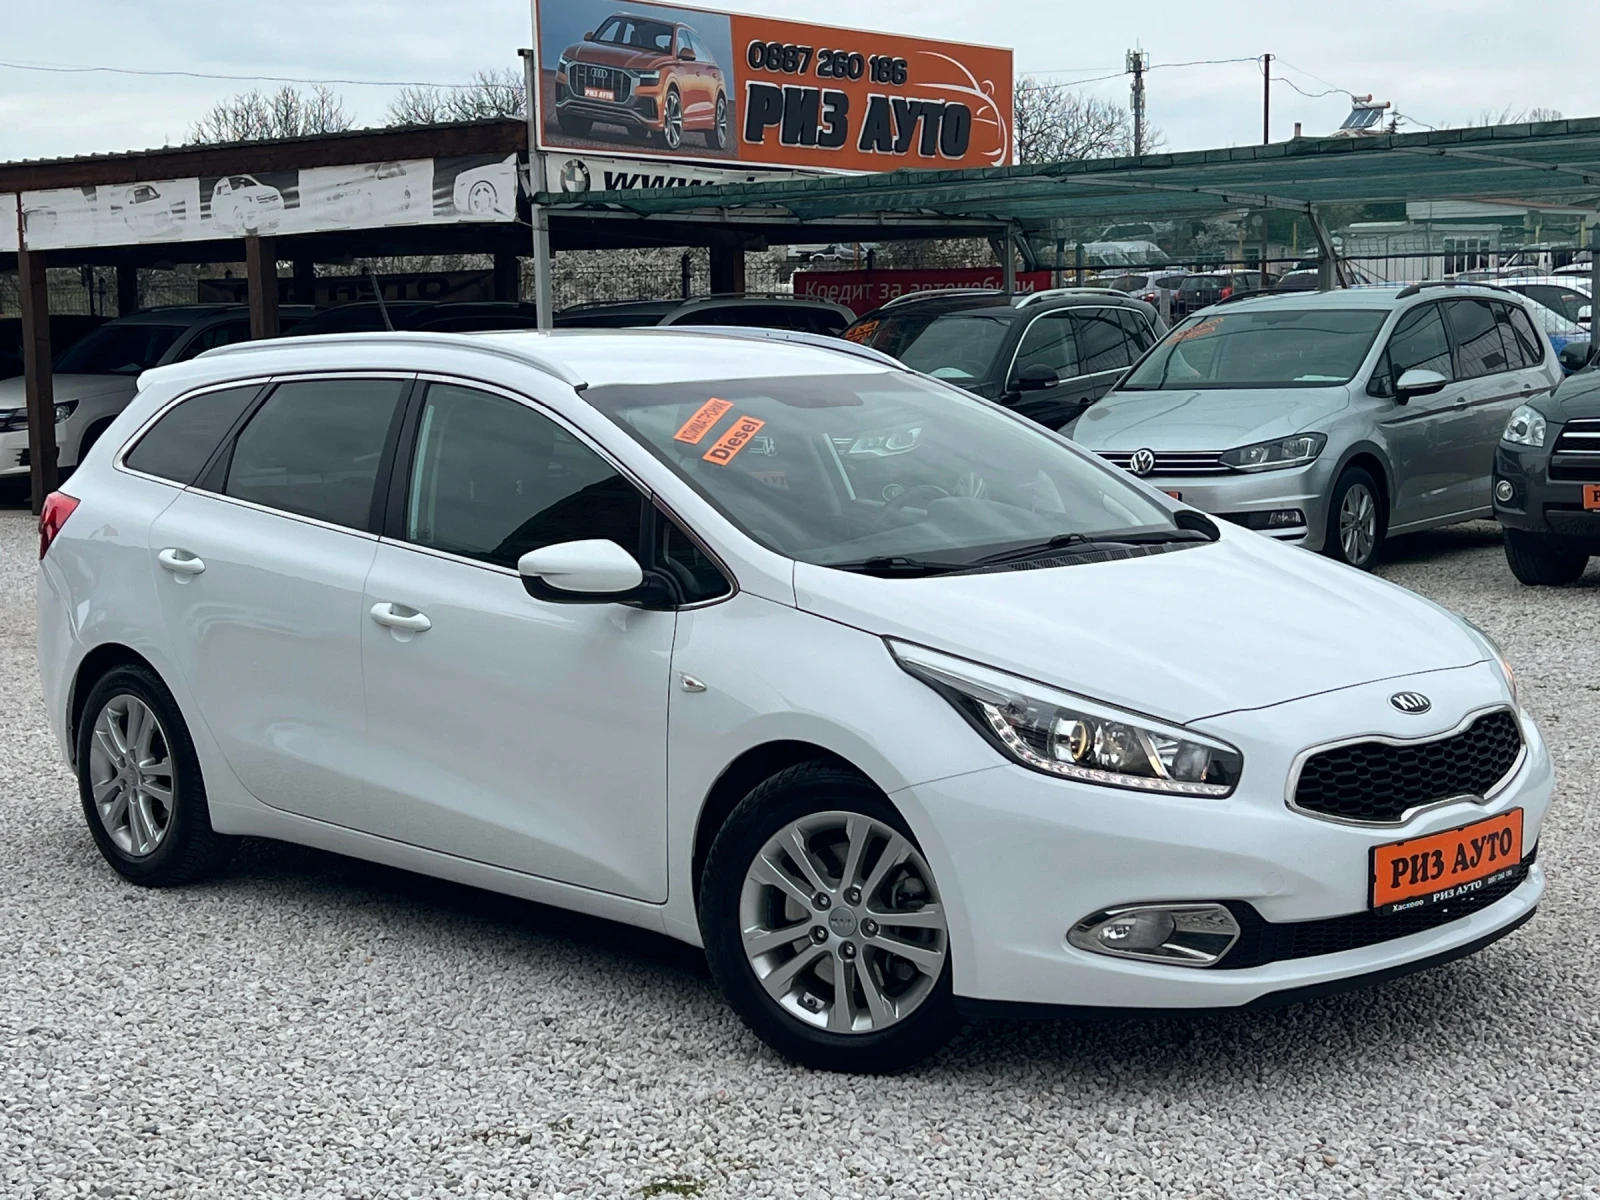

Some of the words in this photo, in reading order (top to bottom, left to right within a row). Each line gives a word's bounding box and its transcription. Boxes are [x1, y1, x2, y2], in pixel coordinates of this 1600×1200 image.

[747, 40, 814, 74] 0887
[816, 48, 865, 80] 260
[868, 55, 908, 85] 186
[743, 81, 849, 149] РИЗ
[857, 93, 971, 160] АУТО
[804, 280, 873, 304] Кредит
[878, 283, 901, 299] за
[709, 418, 760, 461] Diesel
[1391, 693, 1429, 710] KIA
[1390, 849, 1445, 889] РИЗ
[1451, 827, 1513, 875] АУТО
[1432, 888, 1455, 903] РИЗ
[1455, 879, 1483, 896] АУТО
